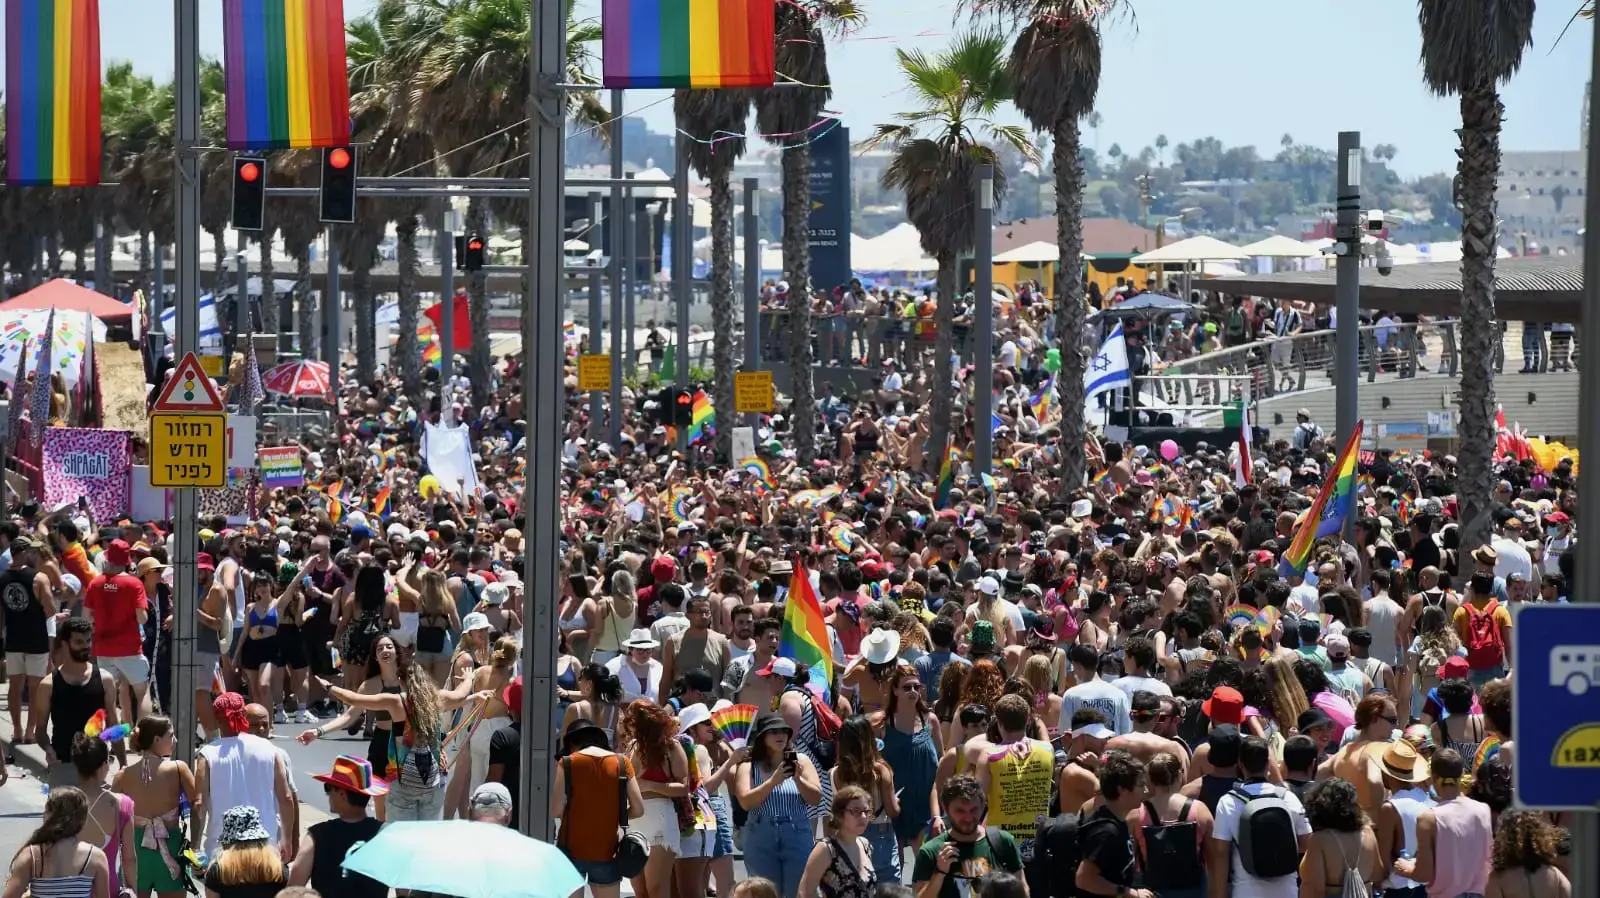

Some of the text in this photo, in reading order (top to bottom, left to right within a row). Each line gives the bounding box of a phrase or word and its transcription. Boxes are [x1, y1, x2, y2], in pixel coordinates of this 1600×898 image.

[818, 229, 837, 237] בננה
[164, 422, 212, 437] רמזור
[169, 443, 208, 457] חדש
[63, 453, 108, 477] SHPAGAT
[164, 462, 212, 481] לפניך
